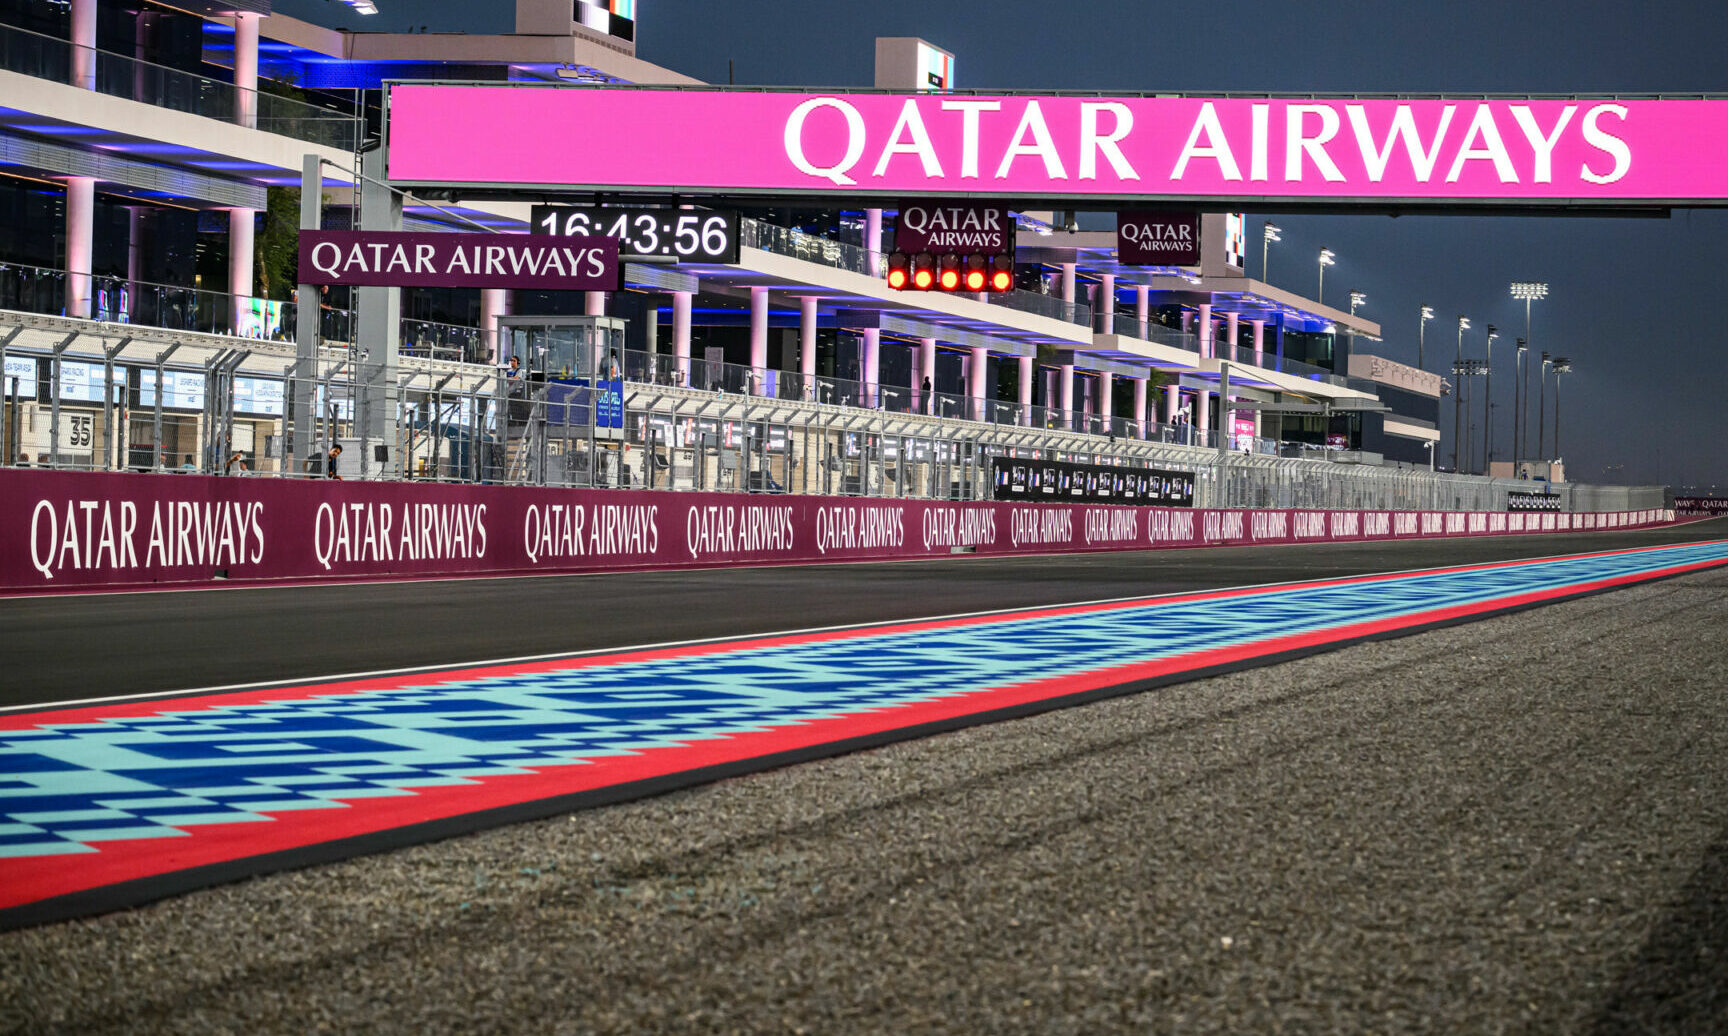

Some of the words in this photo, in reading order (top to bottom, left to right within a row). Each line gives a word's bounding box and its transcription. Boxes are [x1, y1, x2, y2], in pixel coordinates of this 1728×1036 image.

[784, 97, 1140, 186] QATAR
[1170, 102, 1632, 185] AIRWAYS
[541, 212, 728, 256] 16:43:56
[904, 207, 1000, 234] QATAR
[928, 232, 1001, 247] AIRWAYS
[1121, 223, 1193, 242] QATAR
[311, 241, 437, 279] QATAR
[446, 245, 605, 278] AIRWAYS
[1139, 240, 1193, 252] AIRWAYS
[70, 415, 91, 447] 35
[31, 499, 138, 579] QATAR
[146, 501, 264, 568] AIRWAYS
[315, 502, 393, 570] QATAR
[399, 503, 486, 560] AIRWAYS
[524, 503, 584, 564] QATAR
[588, 504, 657, 556] AIRWAYS
[686, 505, 735, 560] QATAR
[737, 505, 794, 552] AIRWAYS
[816, 506, 856, 554] QATAR
[858, 506, 904, 548] AIRWAYS
[923, 507, 955, 550] QATAR
[957, 507, 996, 546] AIRWAYS
[1011, 508, 1039, 547] QATAR
[1040, 508, 1072, 543] AIRWAYS
[1085, 508, 1109, 545] QATAR
[1110, 509, 1137, 541] AIRWAYS
[1148, 510, 1169, 544] QATAR
[1170, 510, 1194, 541] AIRWAYS
